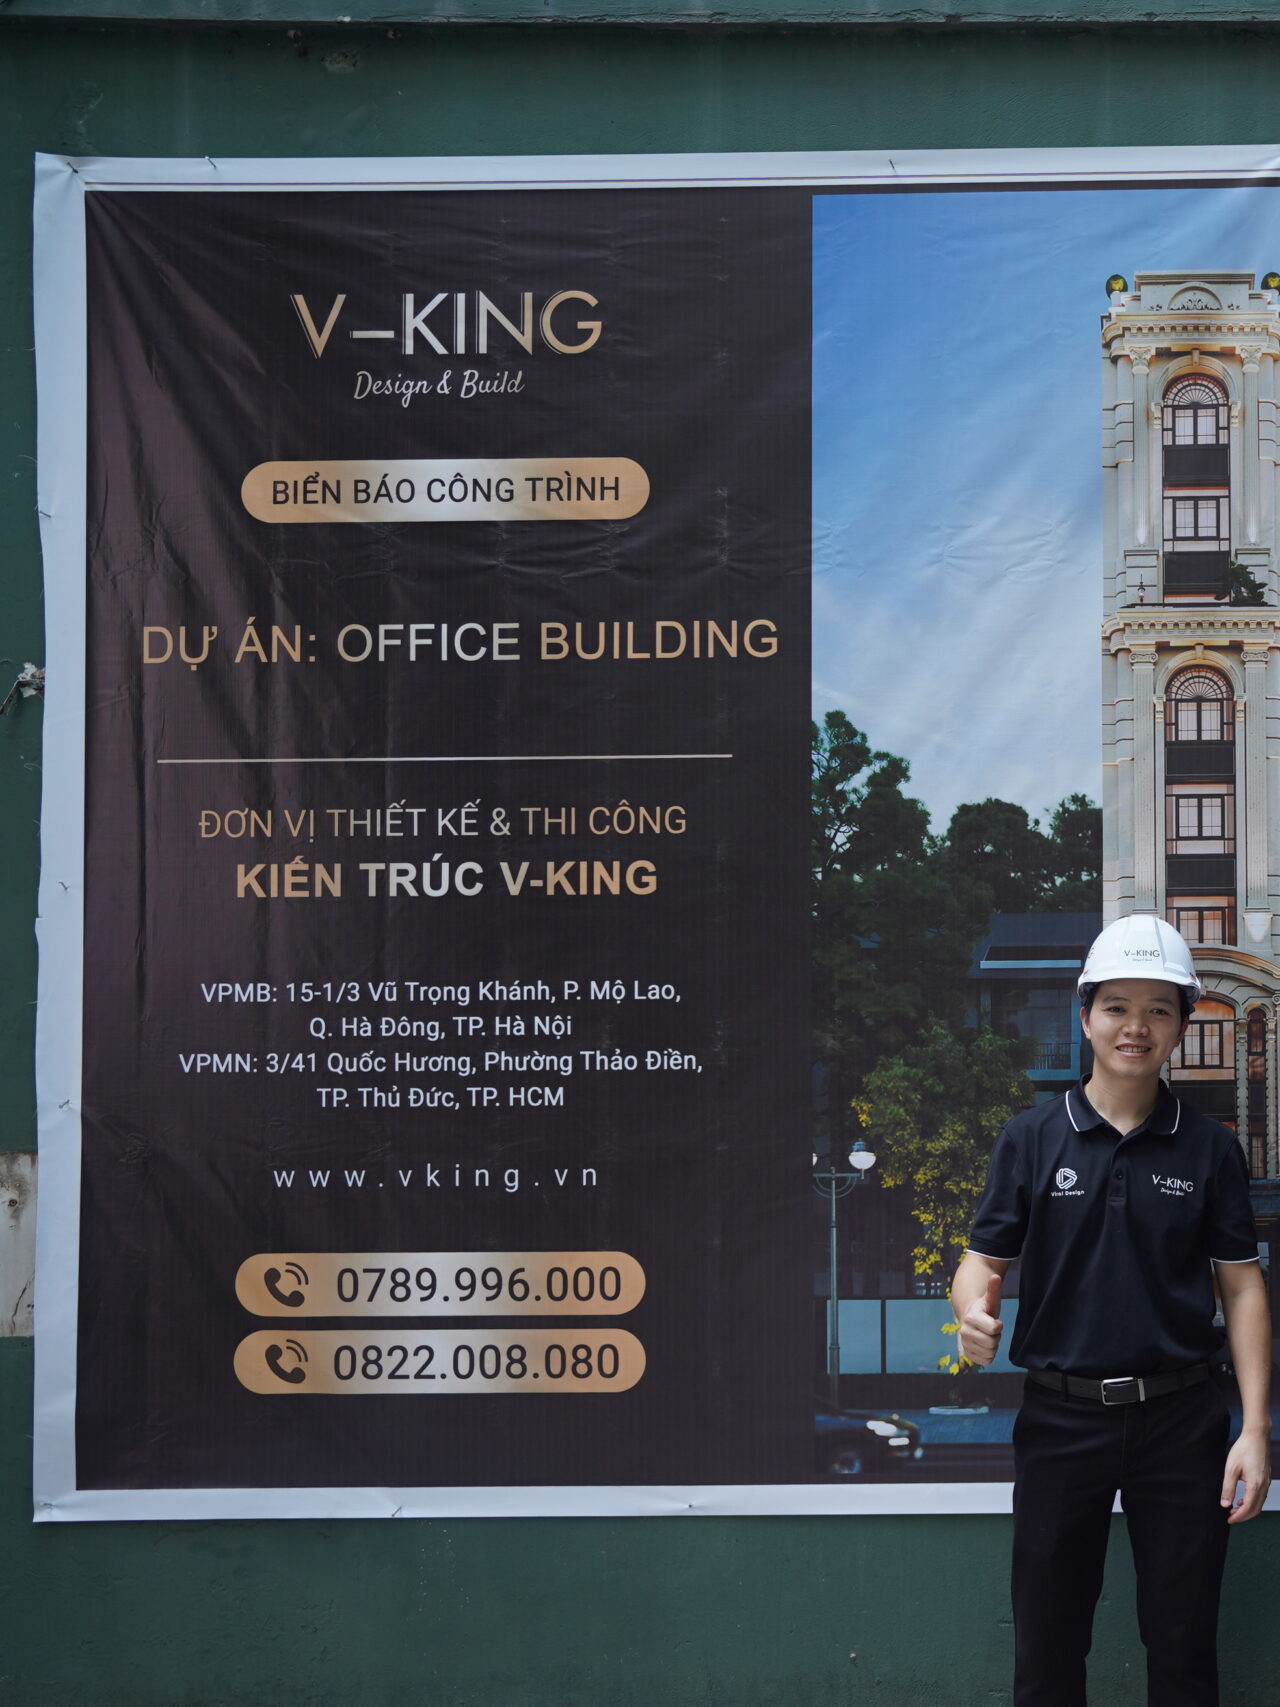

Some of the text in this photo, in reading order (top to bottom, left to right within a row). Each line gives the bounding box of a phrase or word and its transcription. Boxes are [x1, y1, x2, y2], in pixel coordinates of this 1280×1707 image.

[353, 369, 525, 409] Design & Build
[272, 471, 620, 505] BIỂN BÁO CÔNG TRÌNH
[142, 616, 778, 672] DỰ ÁN: OFFICE BUILDING
[197, 798, 686, 843] ĐƠN VỊ THIẾT KẾ & THI CÔNG
[236, 852, 657, 899] KIẾN TRÚC V-KING
[200, 979, 681, 1007] VPMB: 15-1/3 Vũ Trọng Khánh, P. Mộ Lao,
[309, 1014, 572, 1042] Q. Hà Đông, TP. Hà Nội
[178, 1048, 703, 1077] VPMN: 3/41 Quốc Hương, Phường Thảo Điền,
[316, 1085, 564, 1111] TP. Thủ Đức, TP. HCM
[336, 1265, 622, 1303] 0789.996.000
[333, 1343, 620, 1381] 0822.008.080
